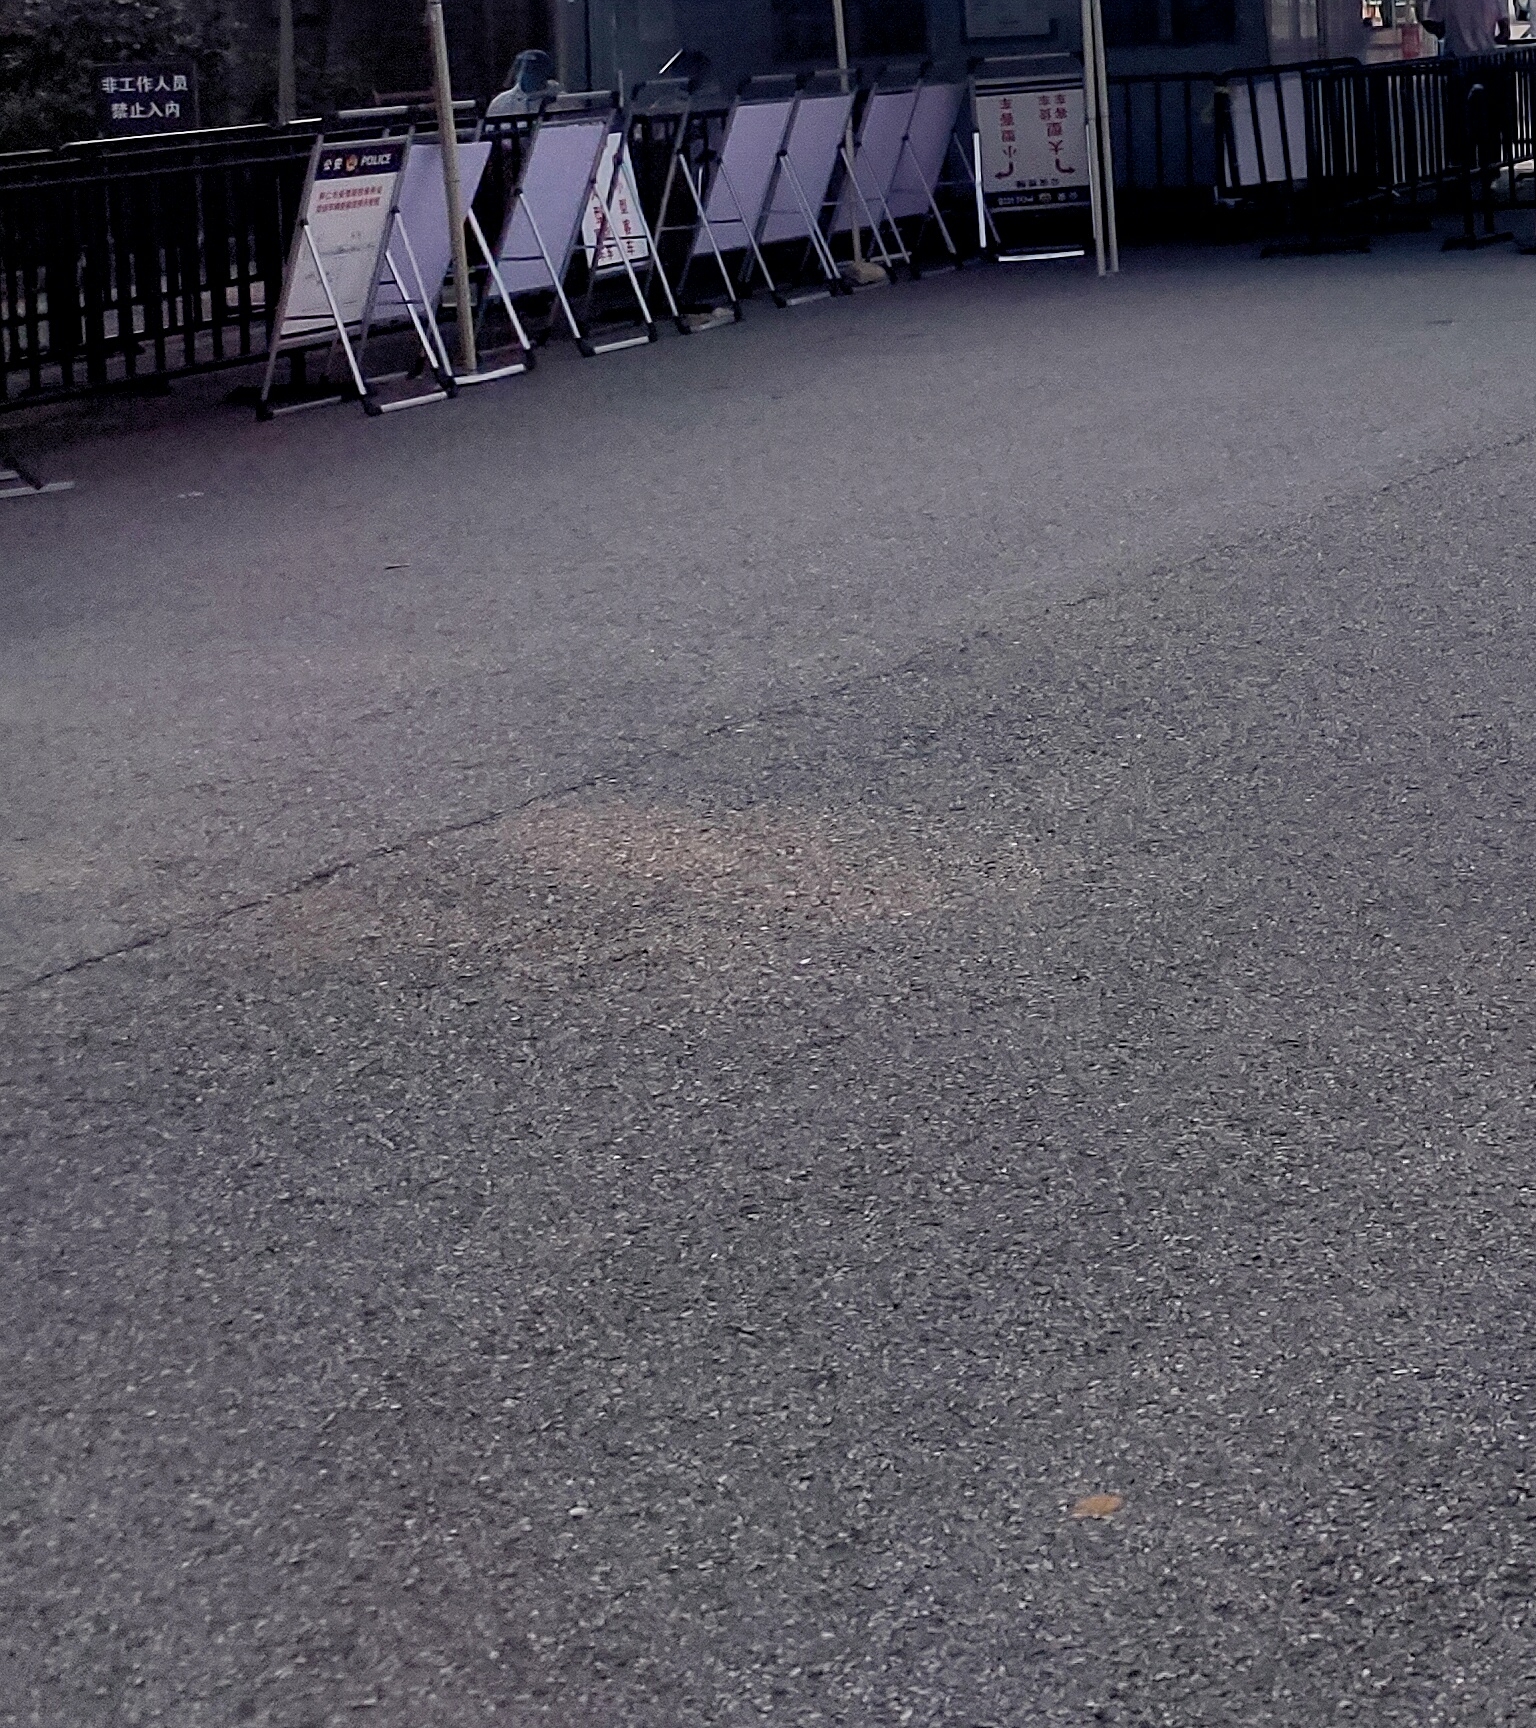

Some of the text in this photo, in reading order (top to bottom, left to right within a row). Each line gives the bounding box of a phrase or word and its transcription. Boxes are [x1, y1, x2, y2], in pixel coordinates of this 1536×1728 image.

[101, 75, 188, 93] 非工作人员
[111, 101, 180, 119] 禁止入内
[323, 153, 392, 171] 公安 POLICE
